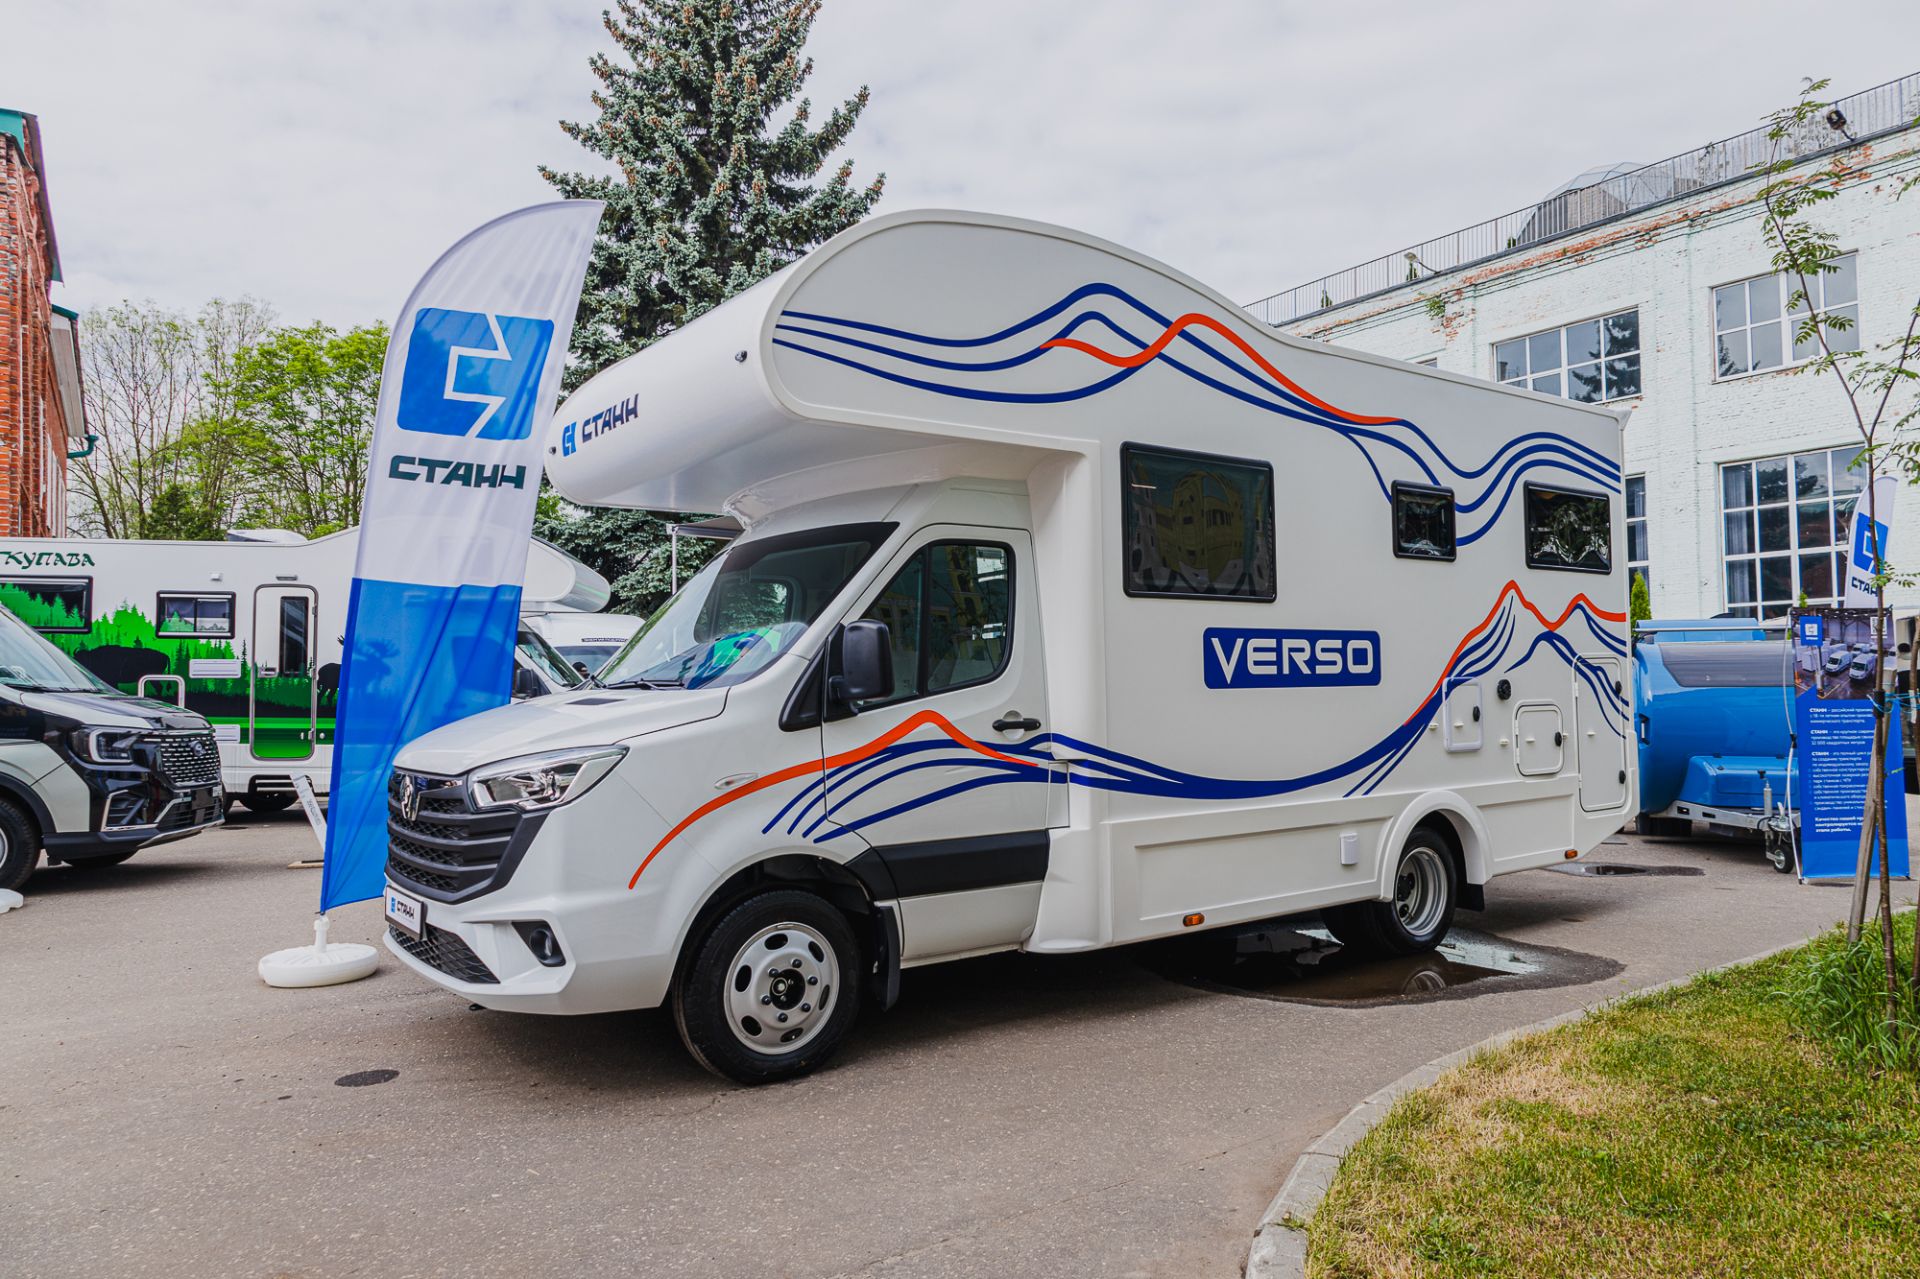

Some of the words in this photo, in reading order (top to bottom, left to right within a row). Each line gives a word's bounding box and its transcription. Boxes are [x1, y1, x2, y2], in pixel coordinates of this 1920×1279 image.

[581, 393, 639, 443] СТАНН
[388, 454, 527, 489] СТАНН
[1211, 637, 1374, 685] VERSO
